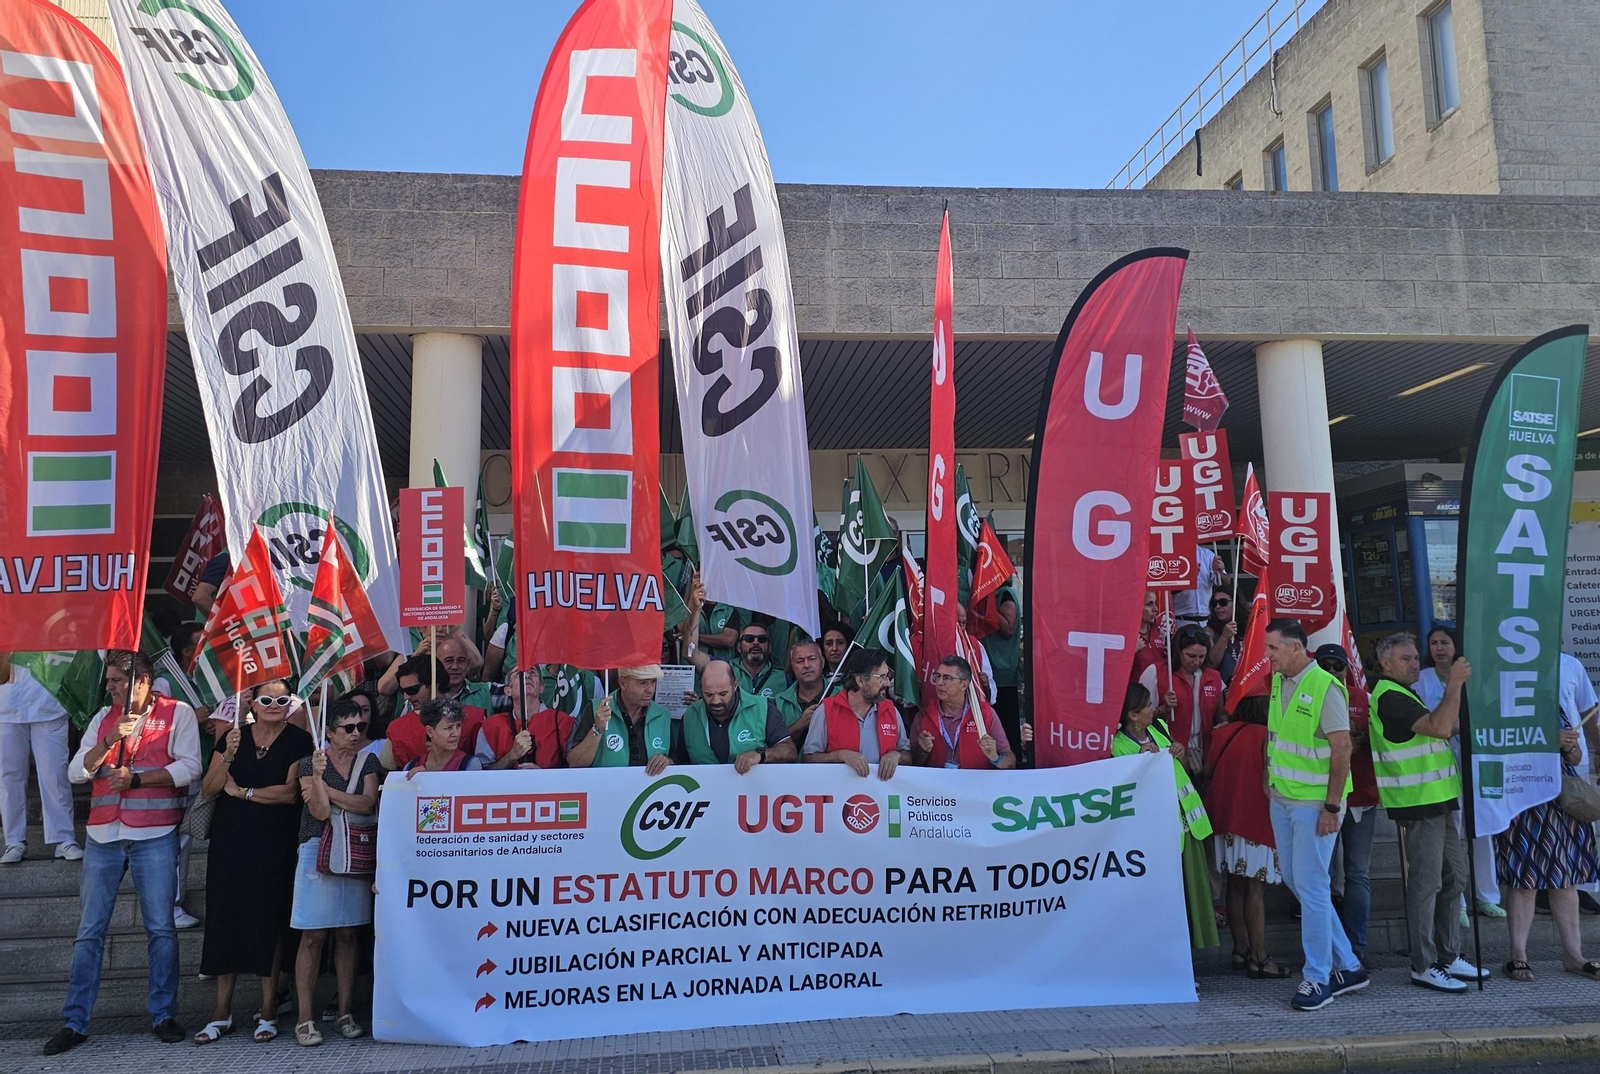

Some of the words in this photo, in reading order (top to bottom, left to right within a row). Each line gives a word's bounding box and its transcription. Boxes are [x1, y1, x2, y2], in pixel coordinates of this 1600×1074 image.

[1512, 410, 1554, 425] SATSE
[1508, 430, 1555, 445] HUELVA
[1187, 435, 1223, 511] UGT
[1068, 351, 1143, 705] UGT
[1151, 466, 1184, 554] UGT
[421, 490, 444, 581] CCOO
[1280, 497, 1318, 583] UGT
[1566, 554, 1600, 563] nforma
[527, 569, 665, 611] HUELVA
[1495, 453, 1553, 718] SATSE
[222, 614, 258, 674] Huelva
[1475, 726, 1547, 747] HUELVA
[462, 800, 556, 826] CCOO
[638, 801, 711, 831] CSIF
[737, 794, 834, 834] UGT
[907, 796, 957, 808] Servicios
[908, 810, 954, 822] Públicos
[991, 782, 1137, 833] SATSE
[416, 834, 469, 844] federación
[472, 834, 485, 843] de
[488, 832, 529, 843] sanidad
[532, 834, 538, 844] y
[540, 831, 584, 841] sectores
[416, 846, 493, 857] sociosanitarios
[496, 846, 509, 855] de
[512, 844, 562, 855] Andalucía
[909, 825, 972, 839] Andalucía
[407, 879, 479, 909] POR
[491, 877, 540, 907] UN
[552, 870, 738, 904] ESTATUTO
[749, 867, 874, 896] MARCO
[885, 866, 977, 895] PARA
[986, 849, 1147, 892] TODOS/AS
[506, 917, 580, 939] NUEVA
[586, 906, 747, 933] CLASIFICACIÓN
[753, 905, 797, 927] CON
[802, 902, 936, 926] ADECUACIÓN
[942, 895, 1066, 922] RETRIBUTIVA
[504, 947, 635, 976] JUBILACIÓN
[641, 945, 732, 968] PARCIAL
[738, 944, 751, 962] Y
[756, 940, 884, 961] ANTICIPADA
[504, 985, 610, 1010] MEJORAS
[616, 984, 644, 1002] EN
[651, 981, 678, 999] LA
[682, 974, 783, 998] JORNADA
[789, 972, 883, 992] LABORAL
